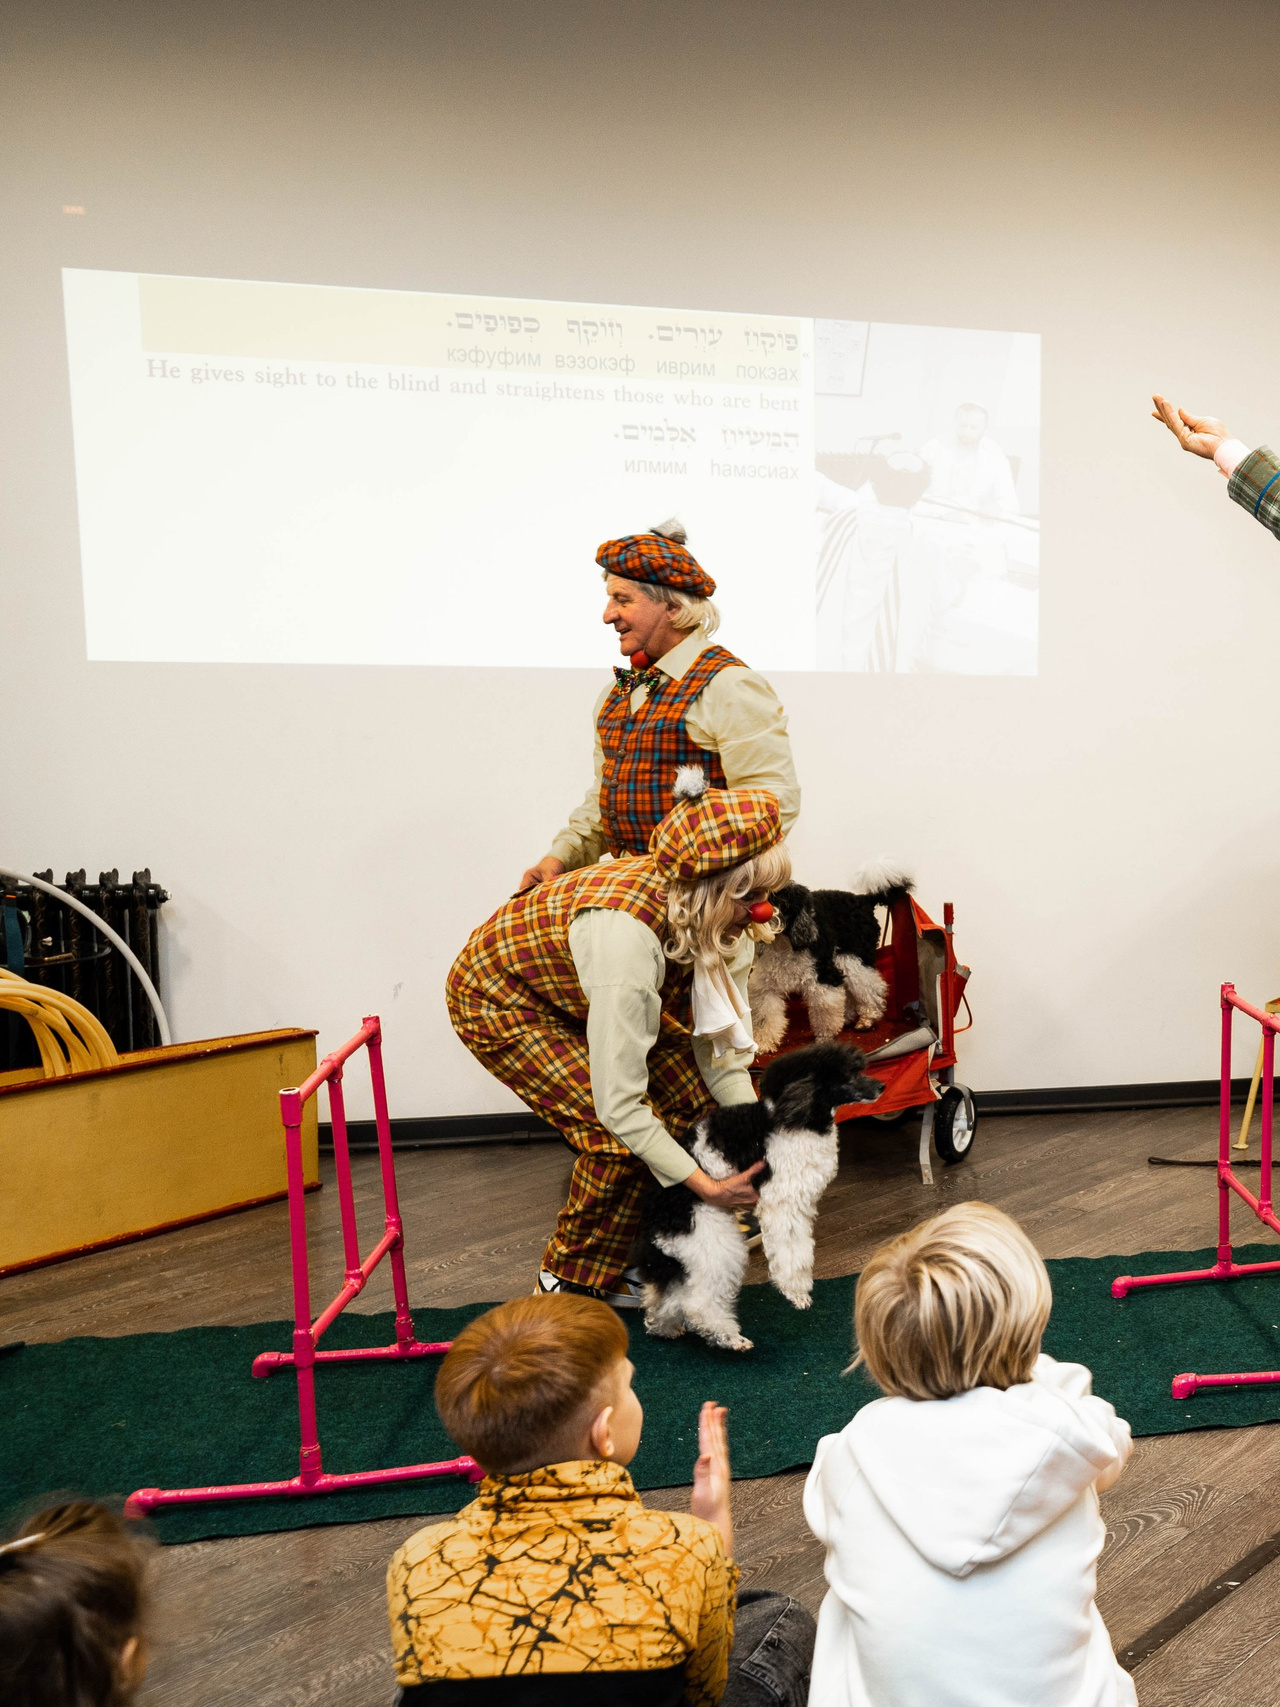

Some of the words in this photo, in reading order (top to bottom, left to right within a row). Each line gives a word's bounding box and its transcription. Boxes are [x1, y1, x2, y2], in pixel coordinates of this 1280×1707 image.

[447, 345, 541, 369] кэфуфим
[554, 353, 636, 377] вэзокэф
[656, 358, 716, 379] иврим
[735, 364, 799, 382] покэах
[146, 358, 181, 379] He
[190, 362, 245, 384] gives
[254, 366, 307, 389] sight
[316, 371, 336, 387] to
[346, 371, 379, 389] the
[388, 373, 440, 393] blind
[449, 377, 486, 395] and
[495, 382, 605, 402] straightens
[613, 385, 665, 405] those
[673, 389, 714, 407] who
[722, 396, 752, 409] are
[759, 393, 800, 412] bent
[624, 458, 688, 475] илмим
